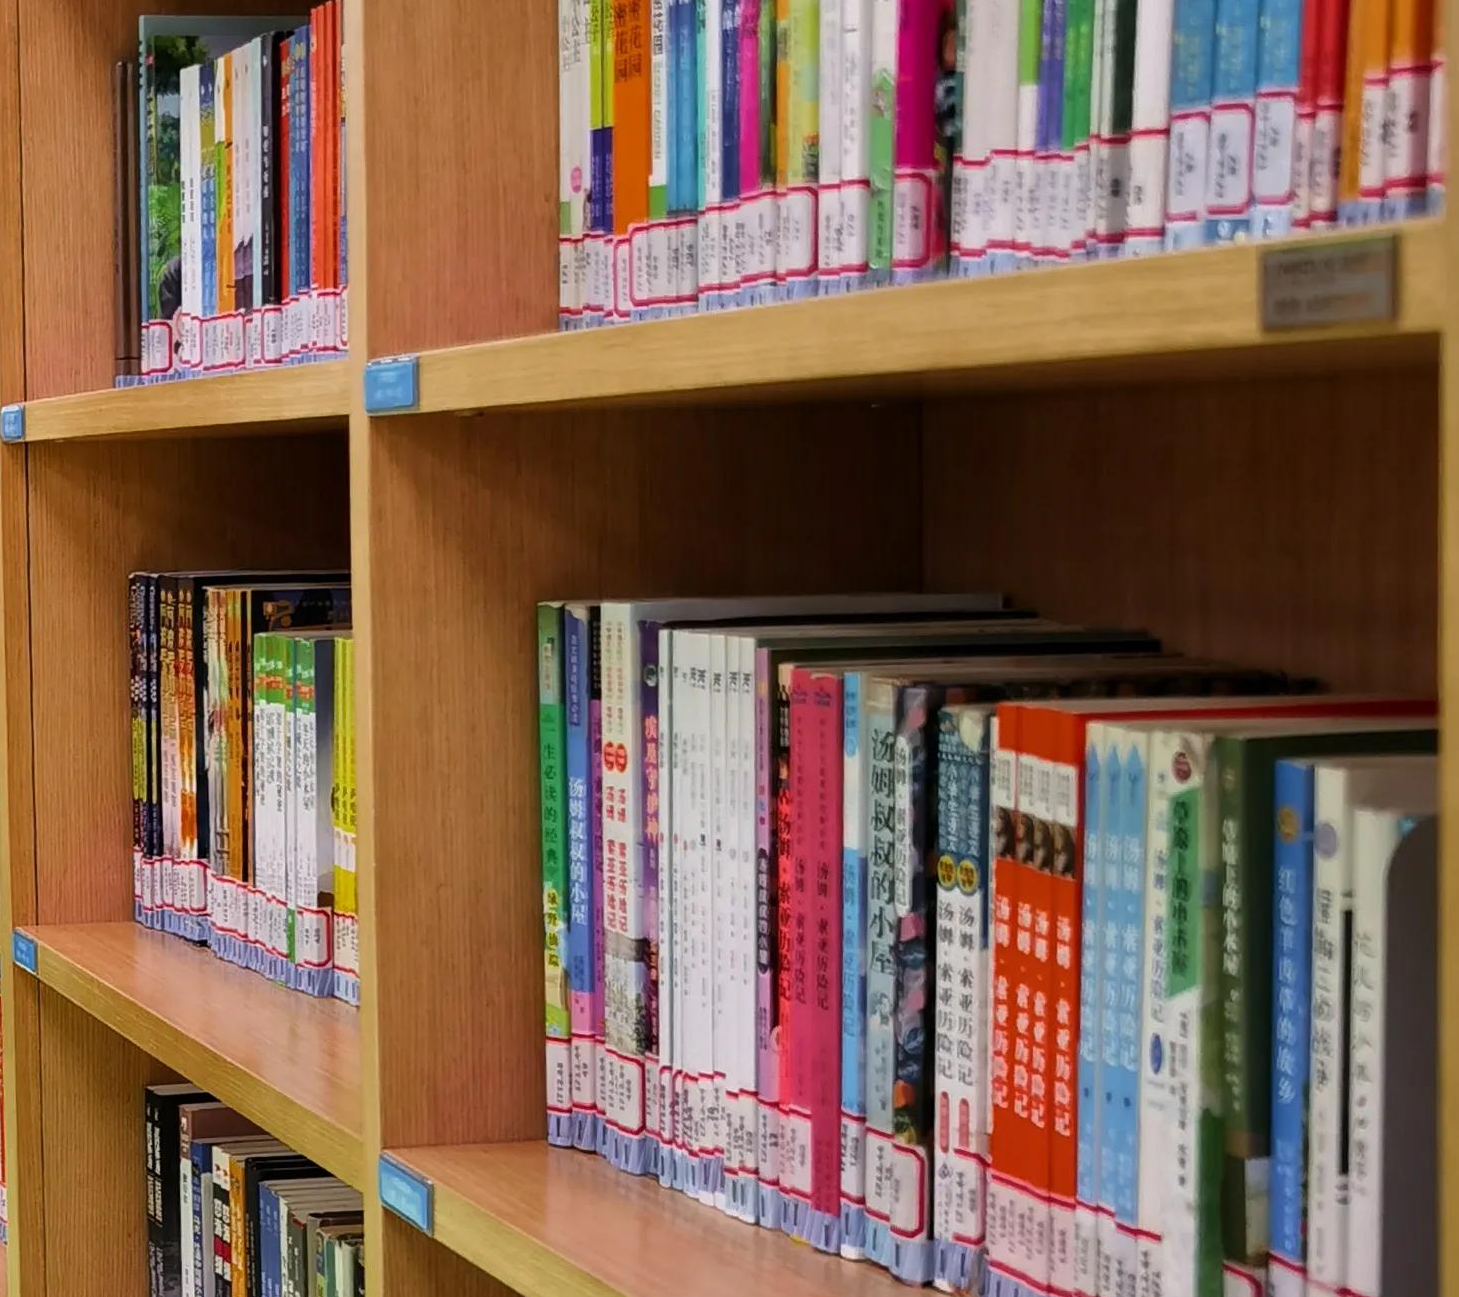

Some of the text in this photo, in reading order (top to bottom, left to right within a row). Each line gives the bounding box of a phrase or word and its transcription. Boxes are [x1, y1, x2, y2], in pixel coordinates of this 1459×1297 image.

[569, 776, 588, 926] 汤姆叔叔的小屋
[870, 727, 895, 975] 汤姆叔叔的小屋
